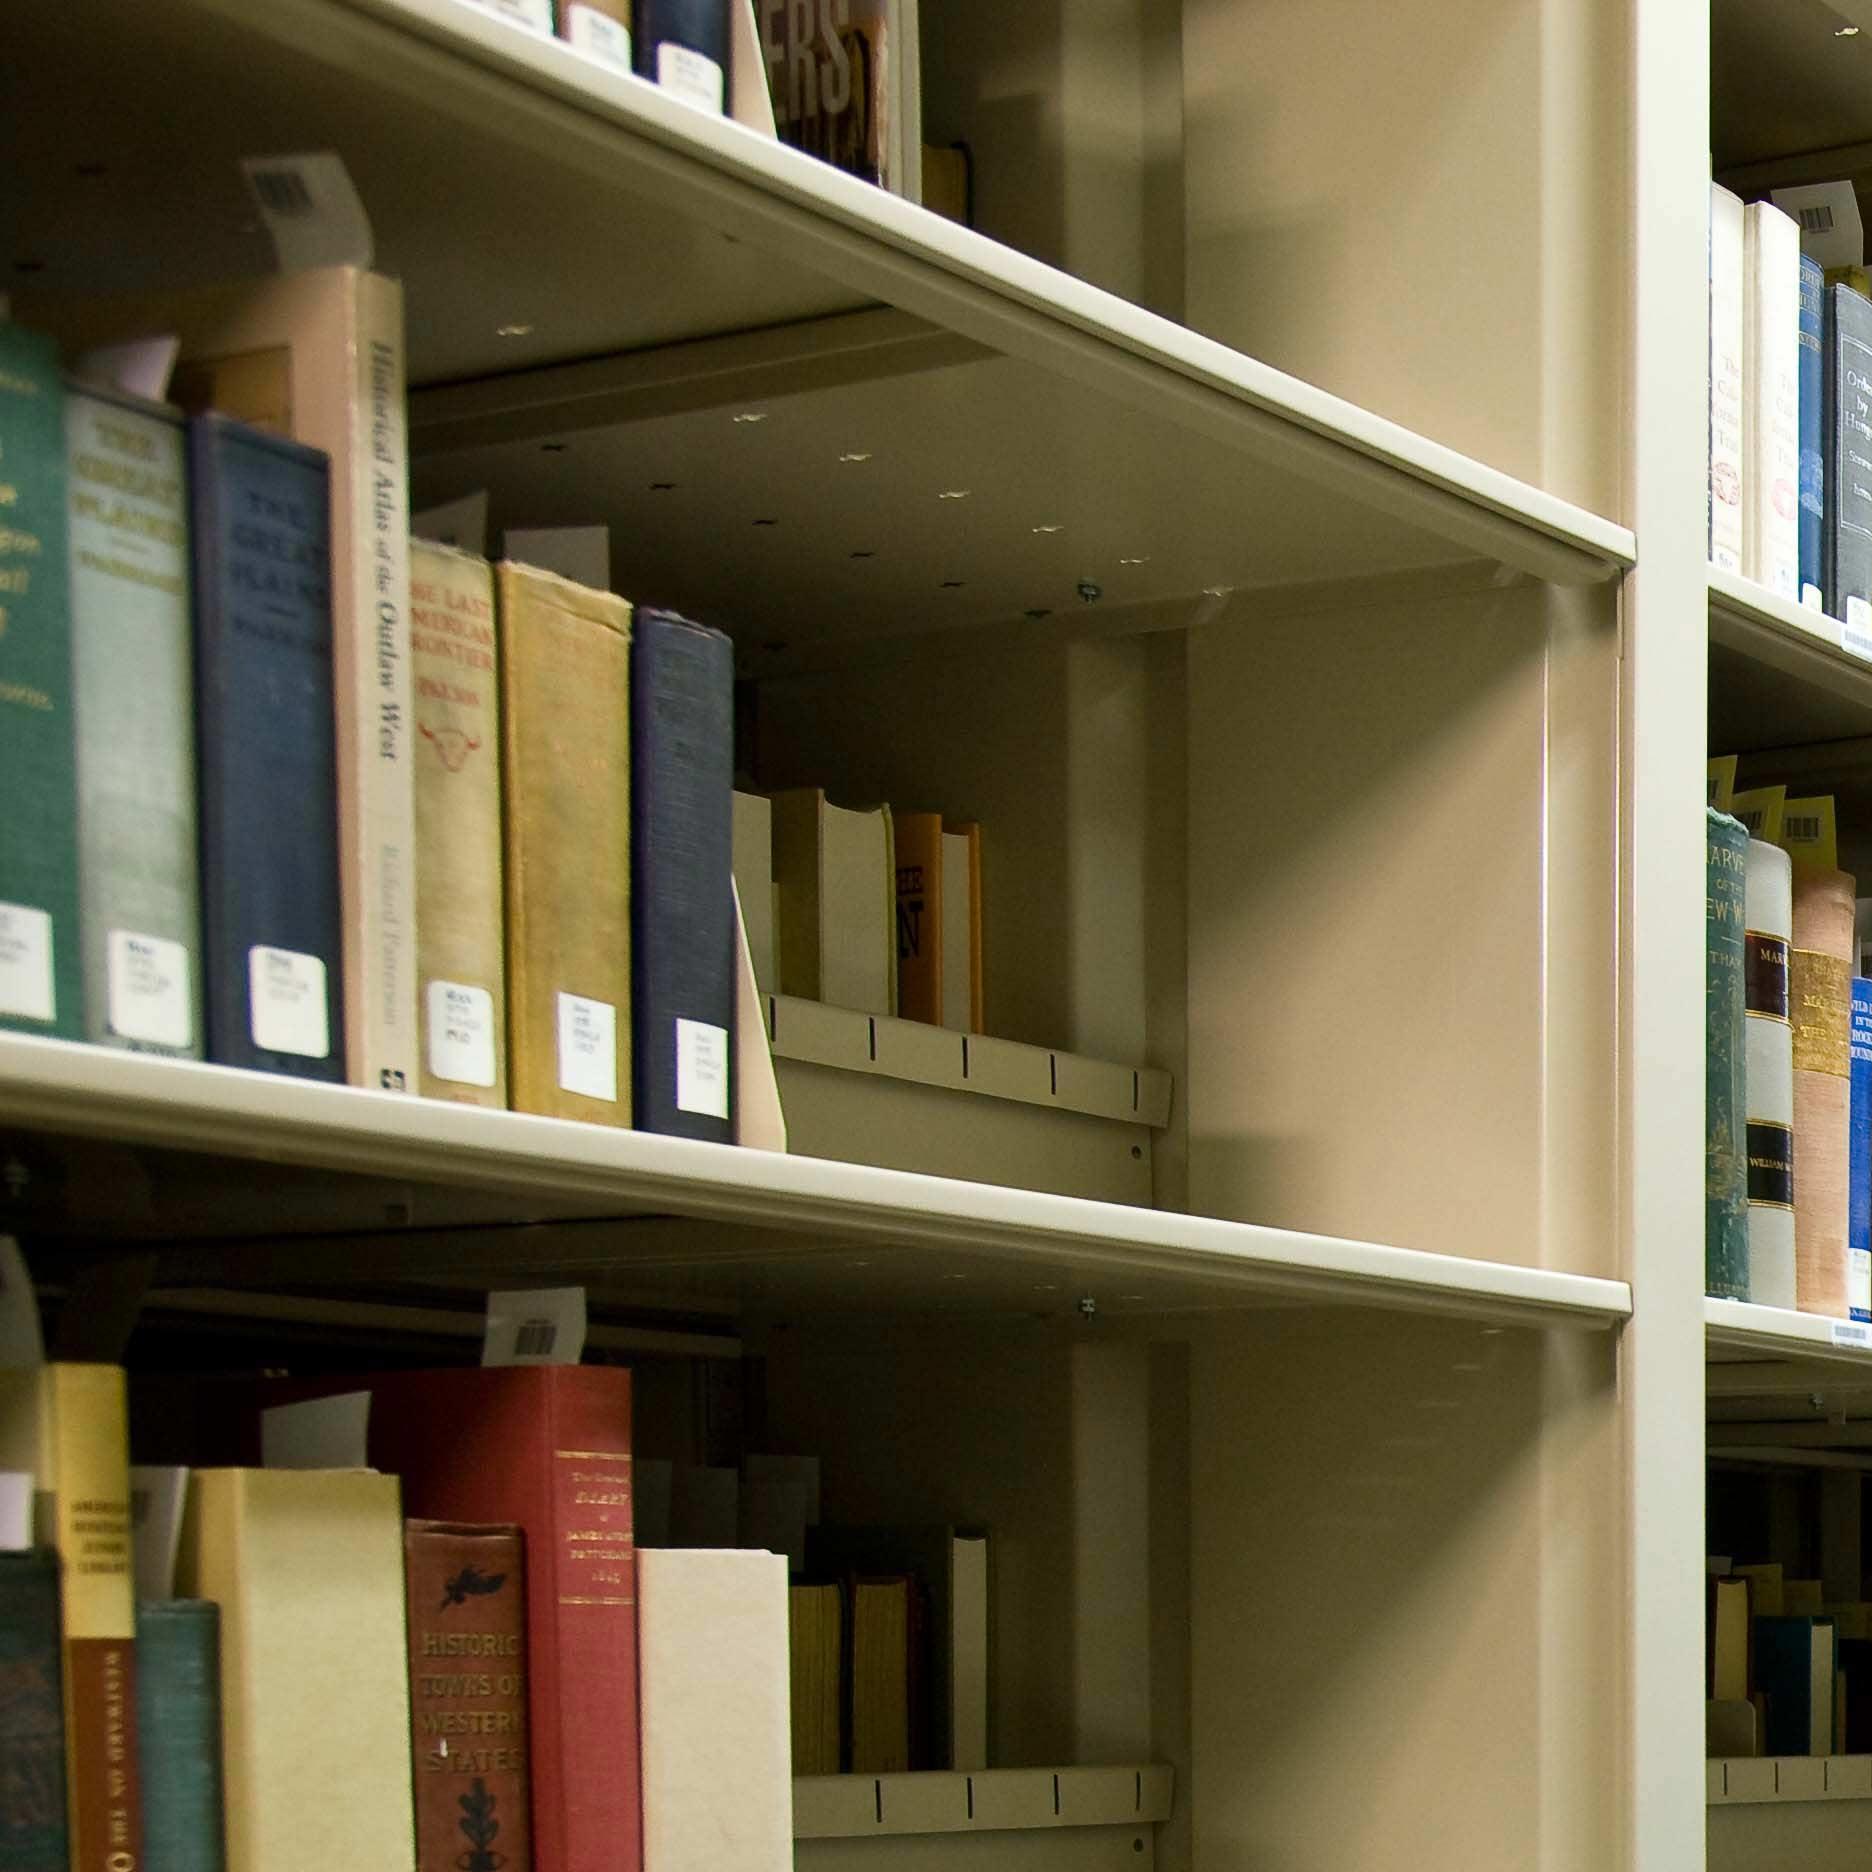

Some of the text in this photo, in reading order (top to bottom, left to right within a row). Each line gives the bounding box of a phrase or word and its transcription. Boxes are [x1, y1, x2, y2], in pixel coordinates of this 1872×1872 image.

[369, 342, 394, 464] Historical
[1856, 396, 1869, 418] by
[374, 469, 395, 532] Atlas
[375, 537, 395, 557] of
[375, 599, 398, 687] Outlaw
[378, 702, 400, 761] West
[422, 1632, 521, 1658] HISTORIC
